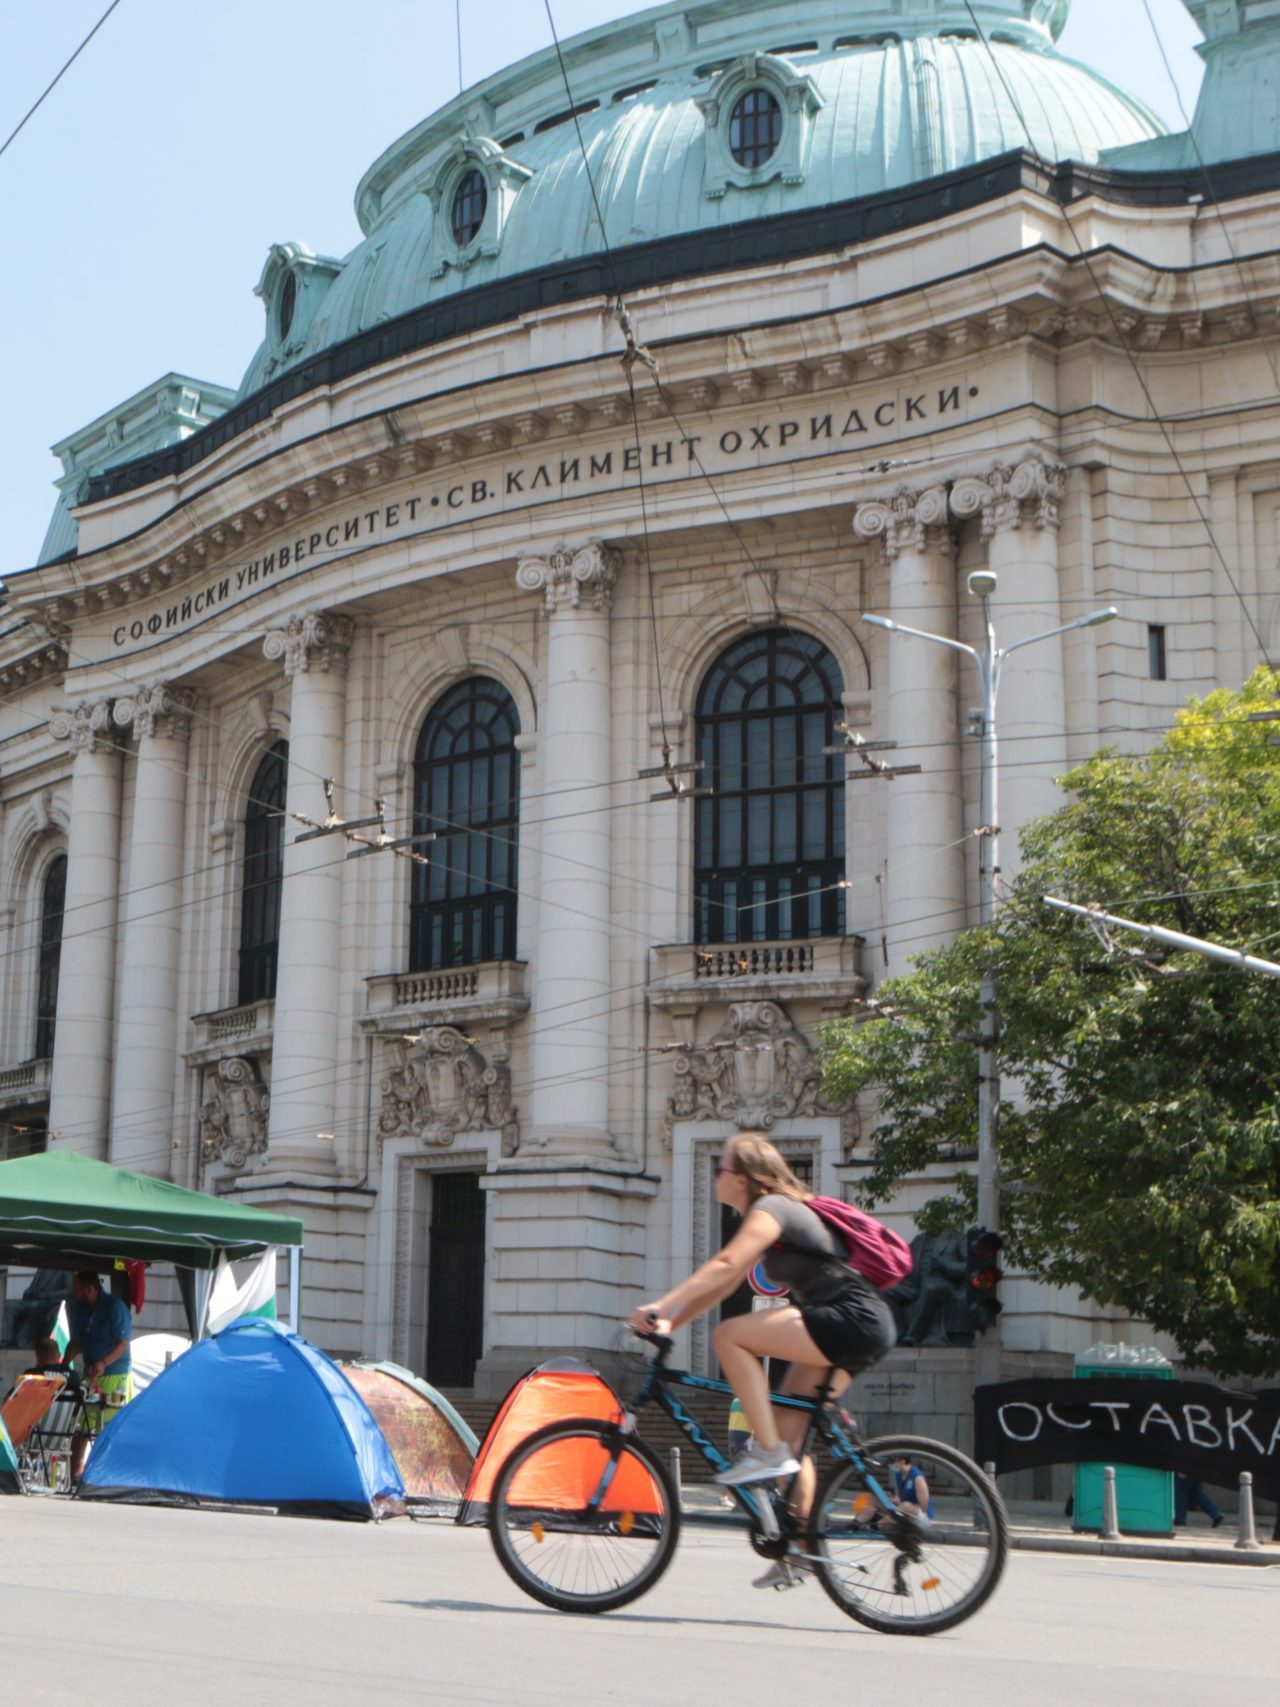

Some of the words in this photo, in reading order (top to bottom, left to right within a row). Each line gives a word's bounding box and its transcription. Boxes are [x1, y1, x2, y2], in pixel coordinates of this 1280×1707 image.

[113, 578, 229, 646] СОФИЙСКИ
[237, 497, 421, 590] УНИВЕРСИТЕТ
[447, 480, 495, 508] СВ.
[505, 436, 702, 494] КЛИМЕНТ
[719, 386, 960, 453] ОХРИДСКИ
